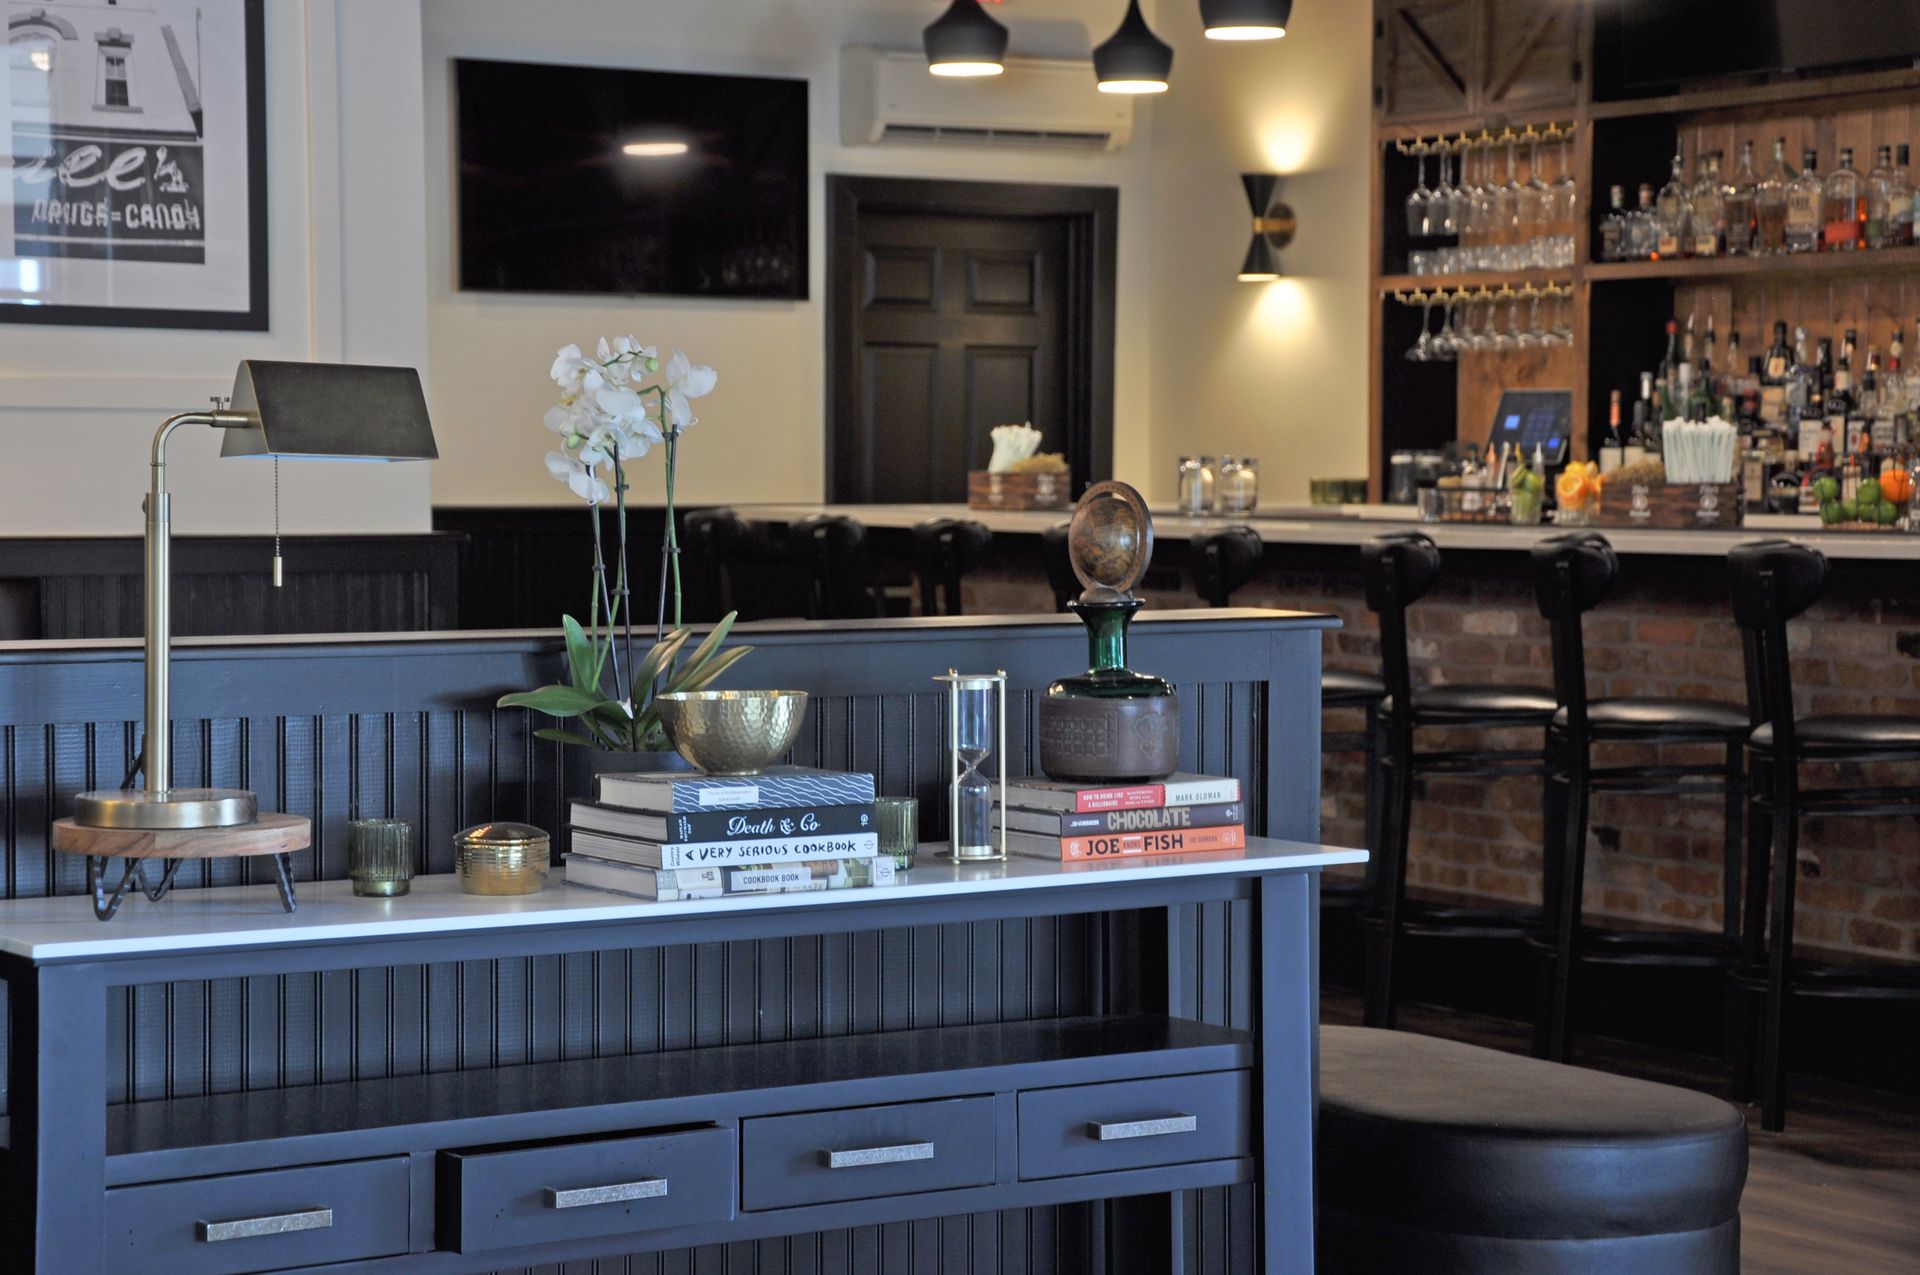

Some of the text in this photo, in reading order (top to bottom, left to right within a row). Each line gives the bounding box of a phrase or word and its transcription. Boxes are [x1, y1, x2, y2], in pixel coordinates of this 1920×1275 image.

[1175, 791, 1221, 802] MARK OLDMAN
[726, 812, 821, 836] Death & Co
[1107, 807, 1191, 831] CHOCOLATE
[685, 840, 856, 861] A VERY SERIOUS COOKBOOK
[1086, 833, 1184, 856] JOE KNOWS FISH
[743, 873, 800, 885] COOKBOOK BOOK
